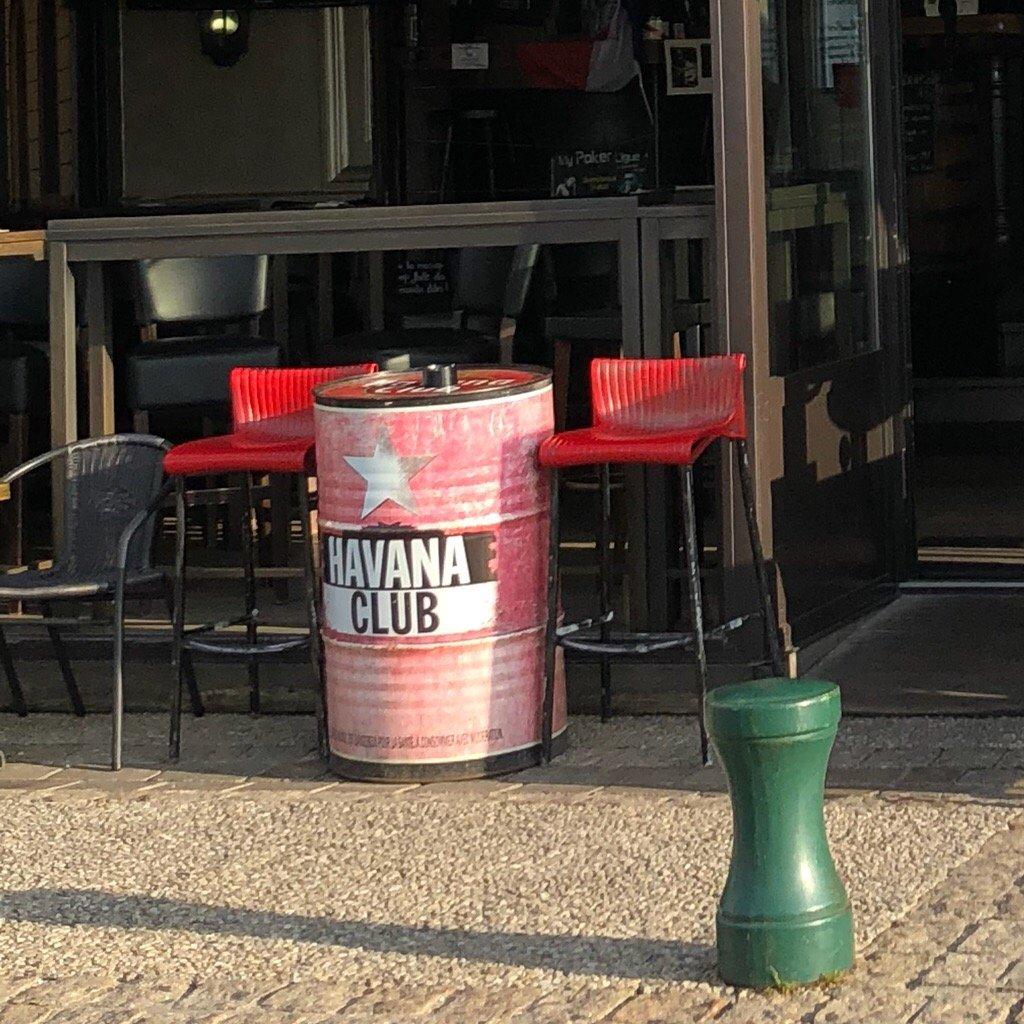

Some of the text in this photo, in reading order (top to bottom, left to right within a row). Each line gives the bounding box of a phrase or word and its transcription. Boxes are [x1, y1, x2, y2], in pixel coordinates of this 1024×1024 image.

[575, 150, 612, 164] Poker
[328, 535, 471, 589] HAVANA
[351, 591, 440, 634] CLUB
